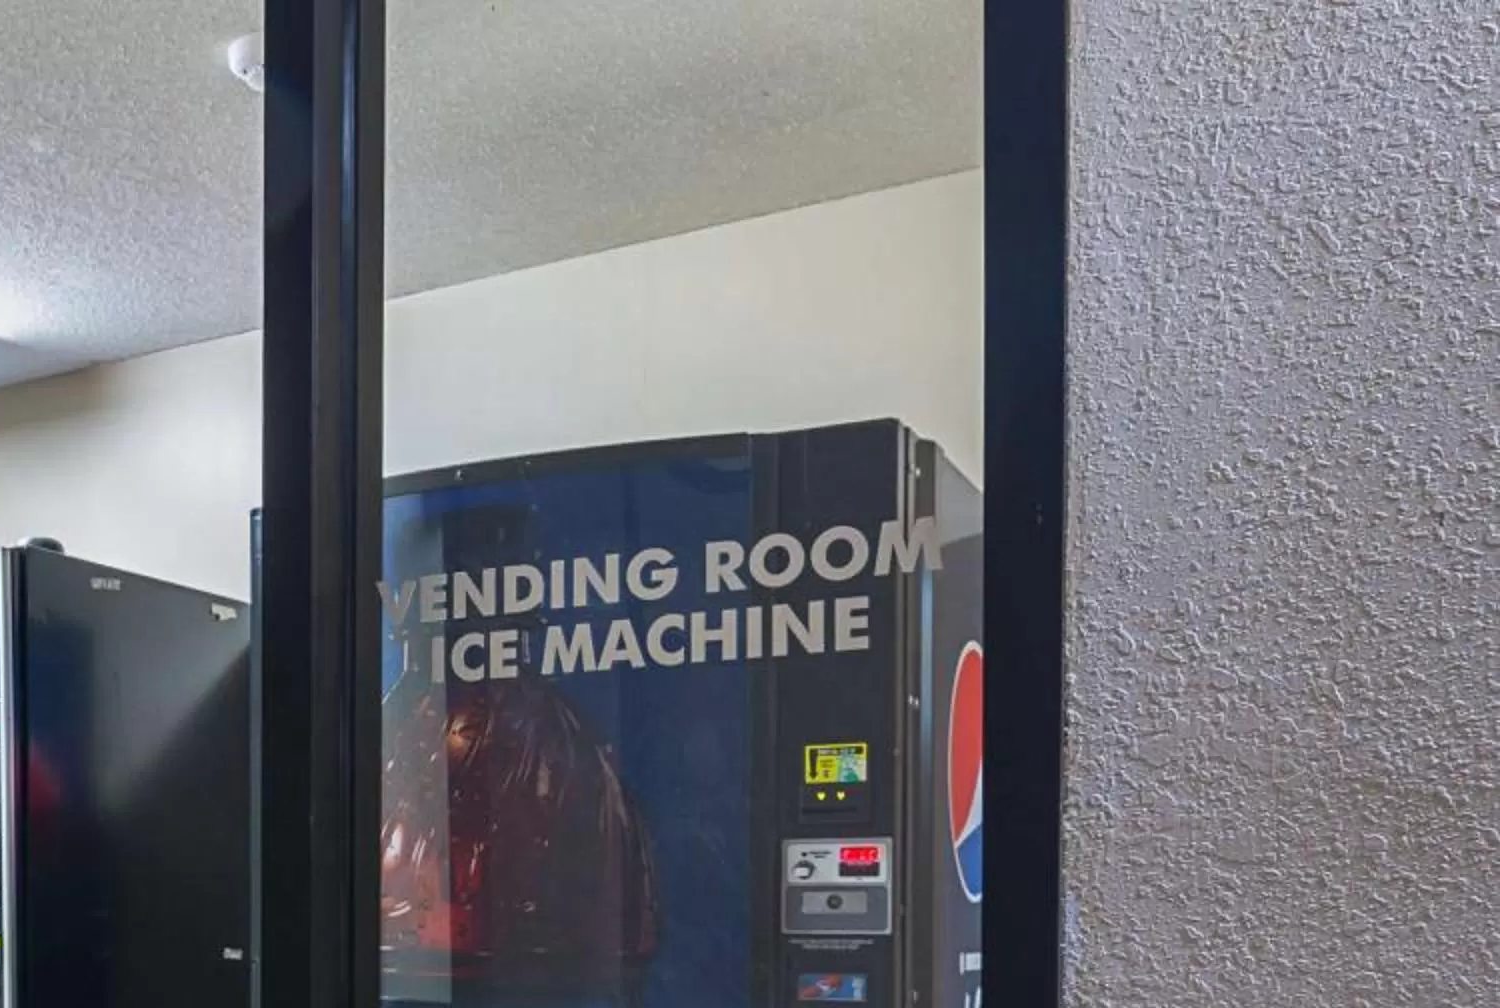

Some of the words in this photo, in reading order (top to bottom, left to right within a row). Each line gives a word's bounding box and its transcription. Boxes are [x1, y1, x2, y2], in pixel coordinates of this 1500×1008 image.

[376, 547, 679, 627] VENDING
[705, 517, 944, 593] ROOM
[431, 628, 520, 683] ICE
[542, 596, 870, 676] MACHINE
